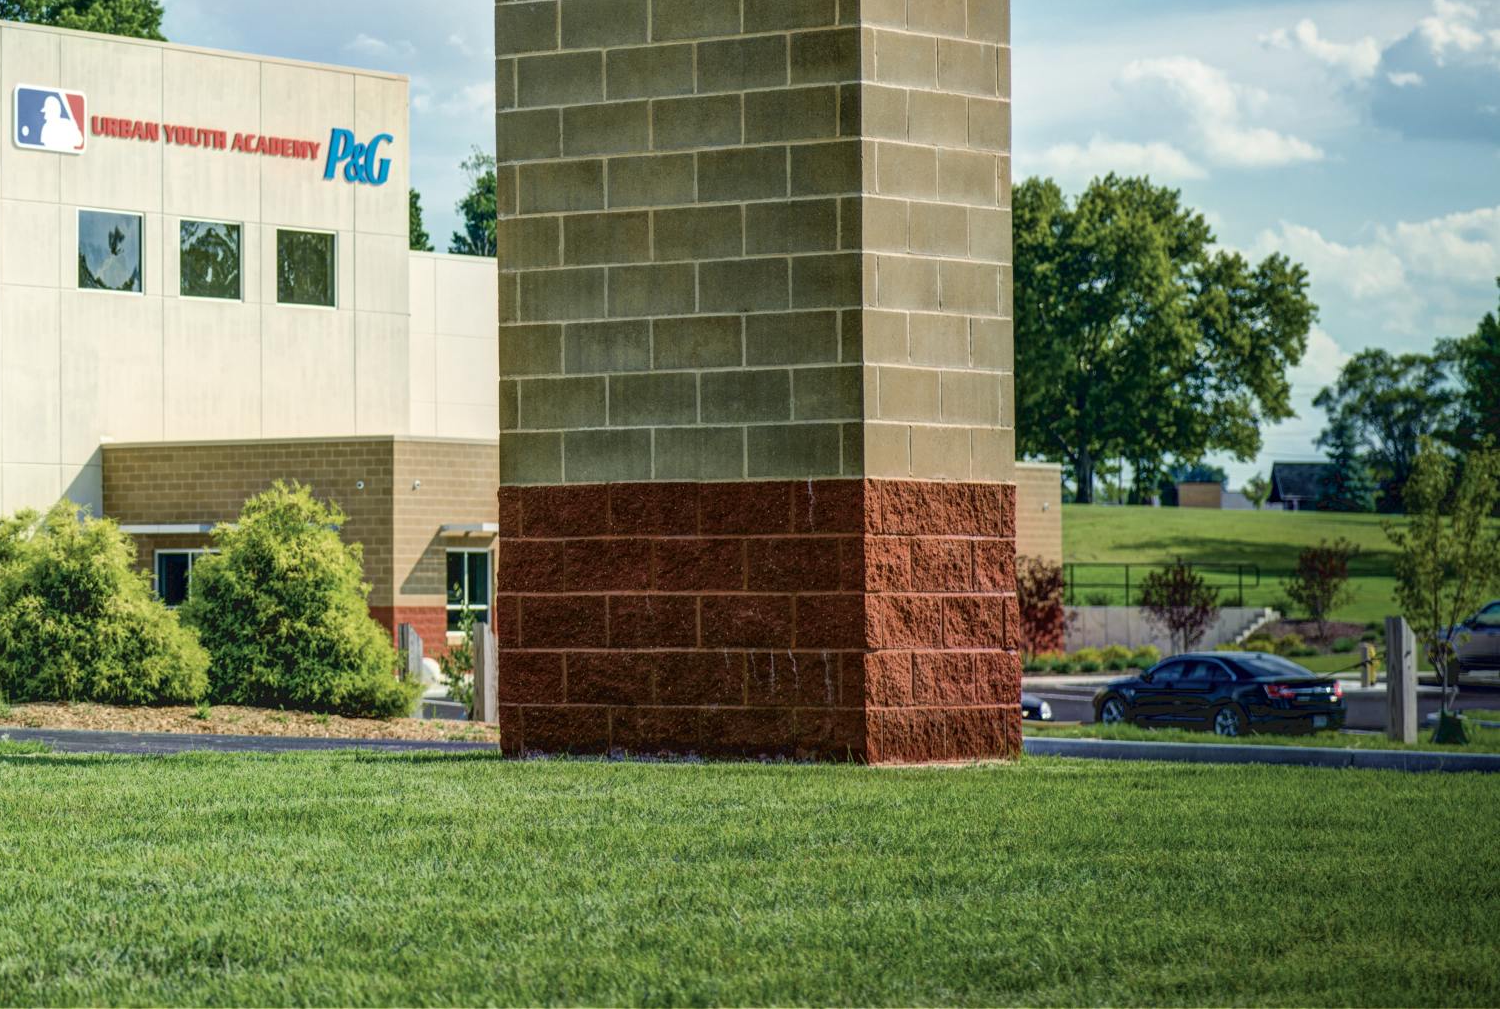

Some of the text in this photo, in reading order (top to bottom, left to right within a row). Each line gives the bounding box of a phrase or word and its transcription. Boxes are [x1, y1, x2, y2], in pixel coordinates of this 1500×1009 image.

[91, 115, 394, 186] URBAN YOUTH ACADEMY P&G
